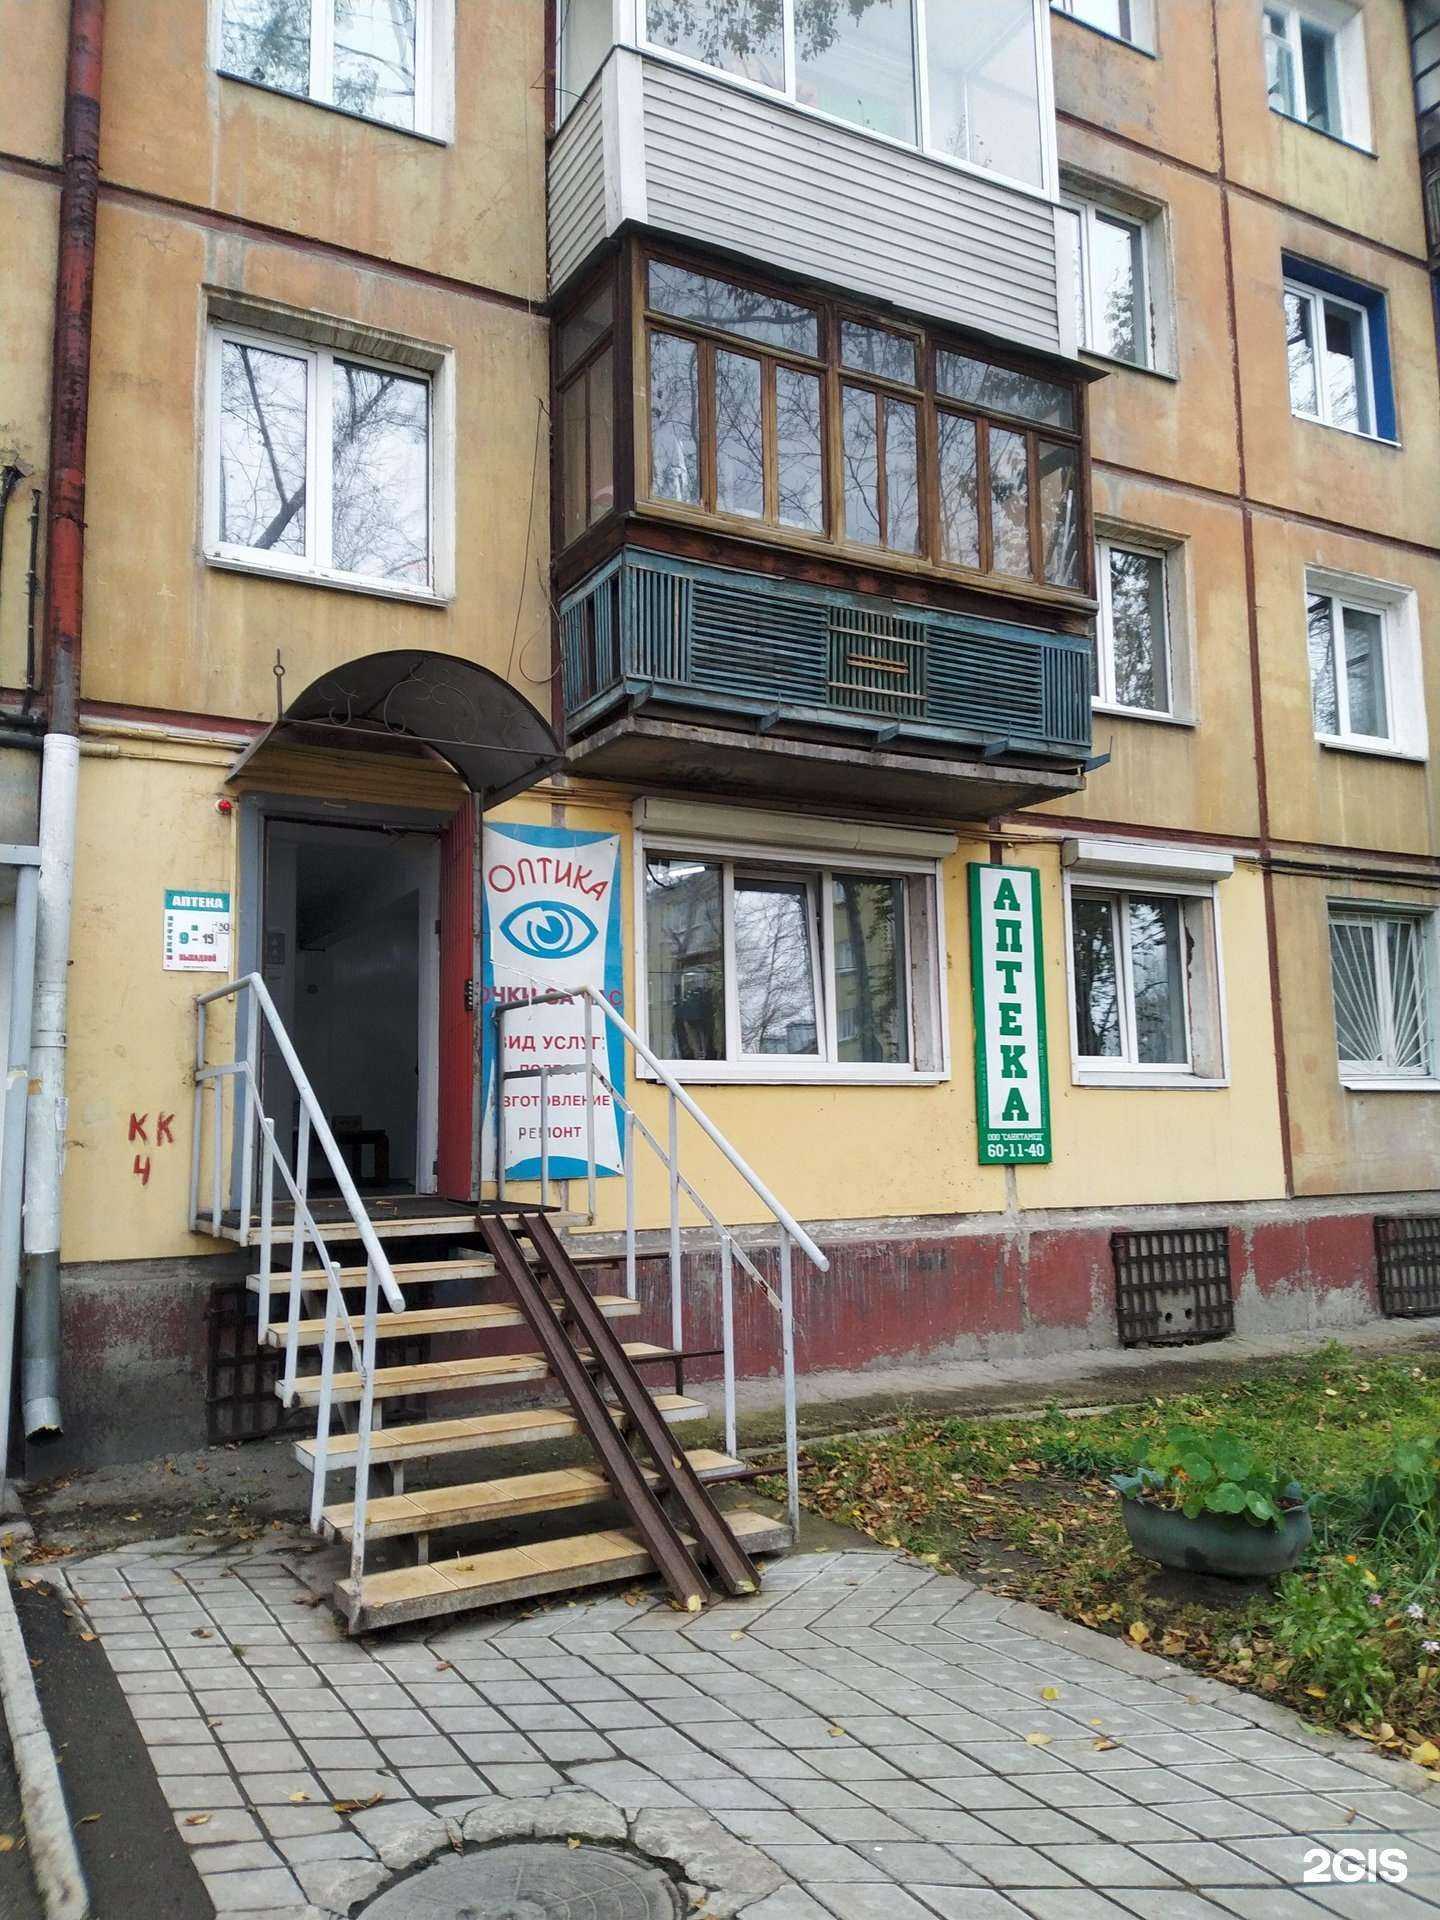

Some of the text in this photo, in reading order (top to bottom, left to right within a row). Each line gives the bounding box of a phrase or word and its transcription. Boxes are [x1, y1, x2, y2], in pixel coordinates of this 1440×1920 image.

[488, 857, 609, 901] ОПТИКА
[172, 895, 224, 909] АПТЕКА
[179, 931, 189, 945] 9
[993, 878, 1029, 1122] АПТЕКА
[503, 1036, 536, 1052] ИД
[503, 1095, 611, 1108] ЗГОТВЛЕИЕ
[987, 1143, 1045, 1158] 60-11-40
